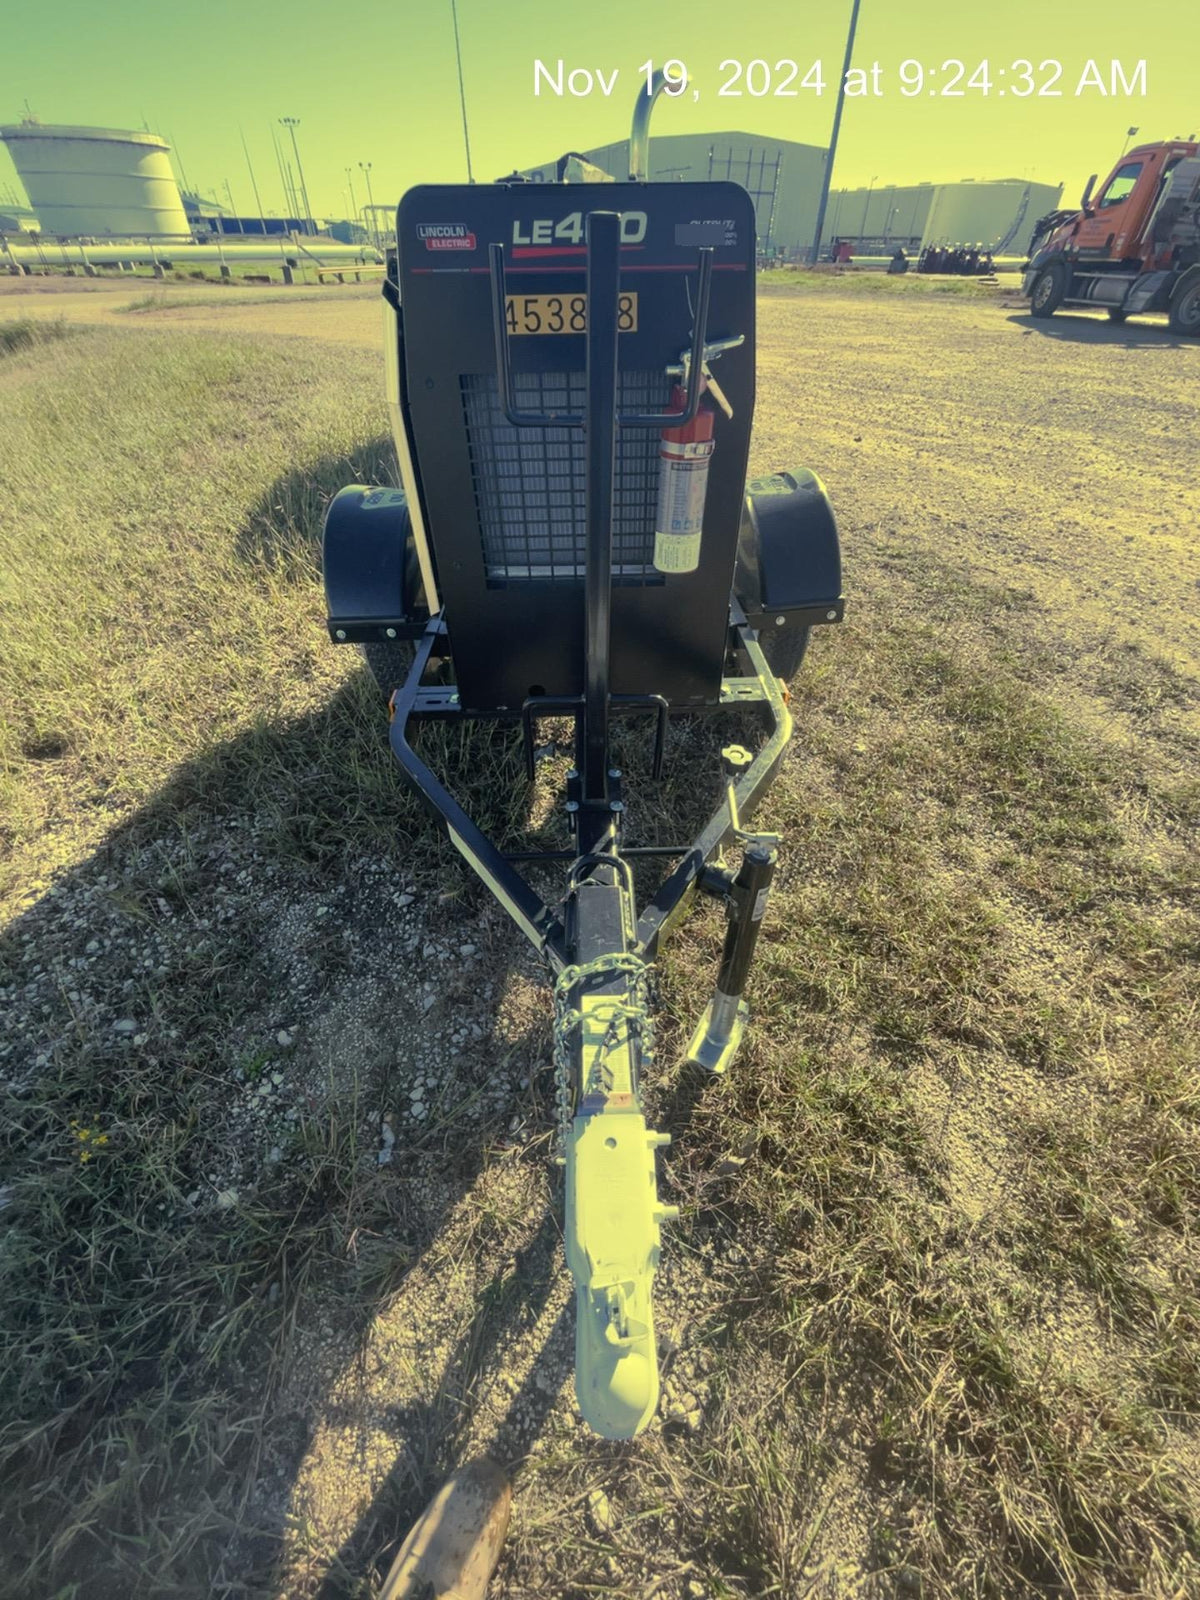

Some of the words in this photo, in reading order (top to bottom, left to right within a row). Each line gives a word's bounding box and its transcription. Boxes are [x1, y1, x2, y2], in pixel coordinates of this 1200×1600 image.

[420, 227, 464, 237] LINCOLN
[512, 211, 648, 244] LE40
[432, 239, 470, 248] ELECTRIC
[506, 297, 634, 332] 45388
